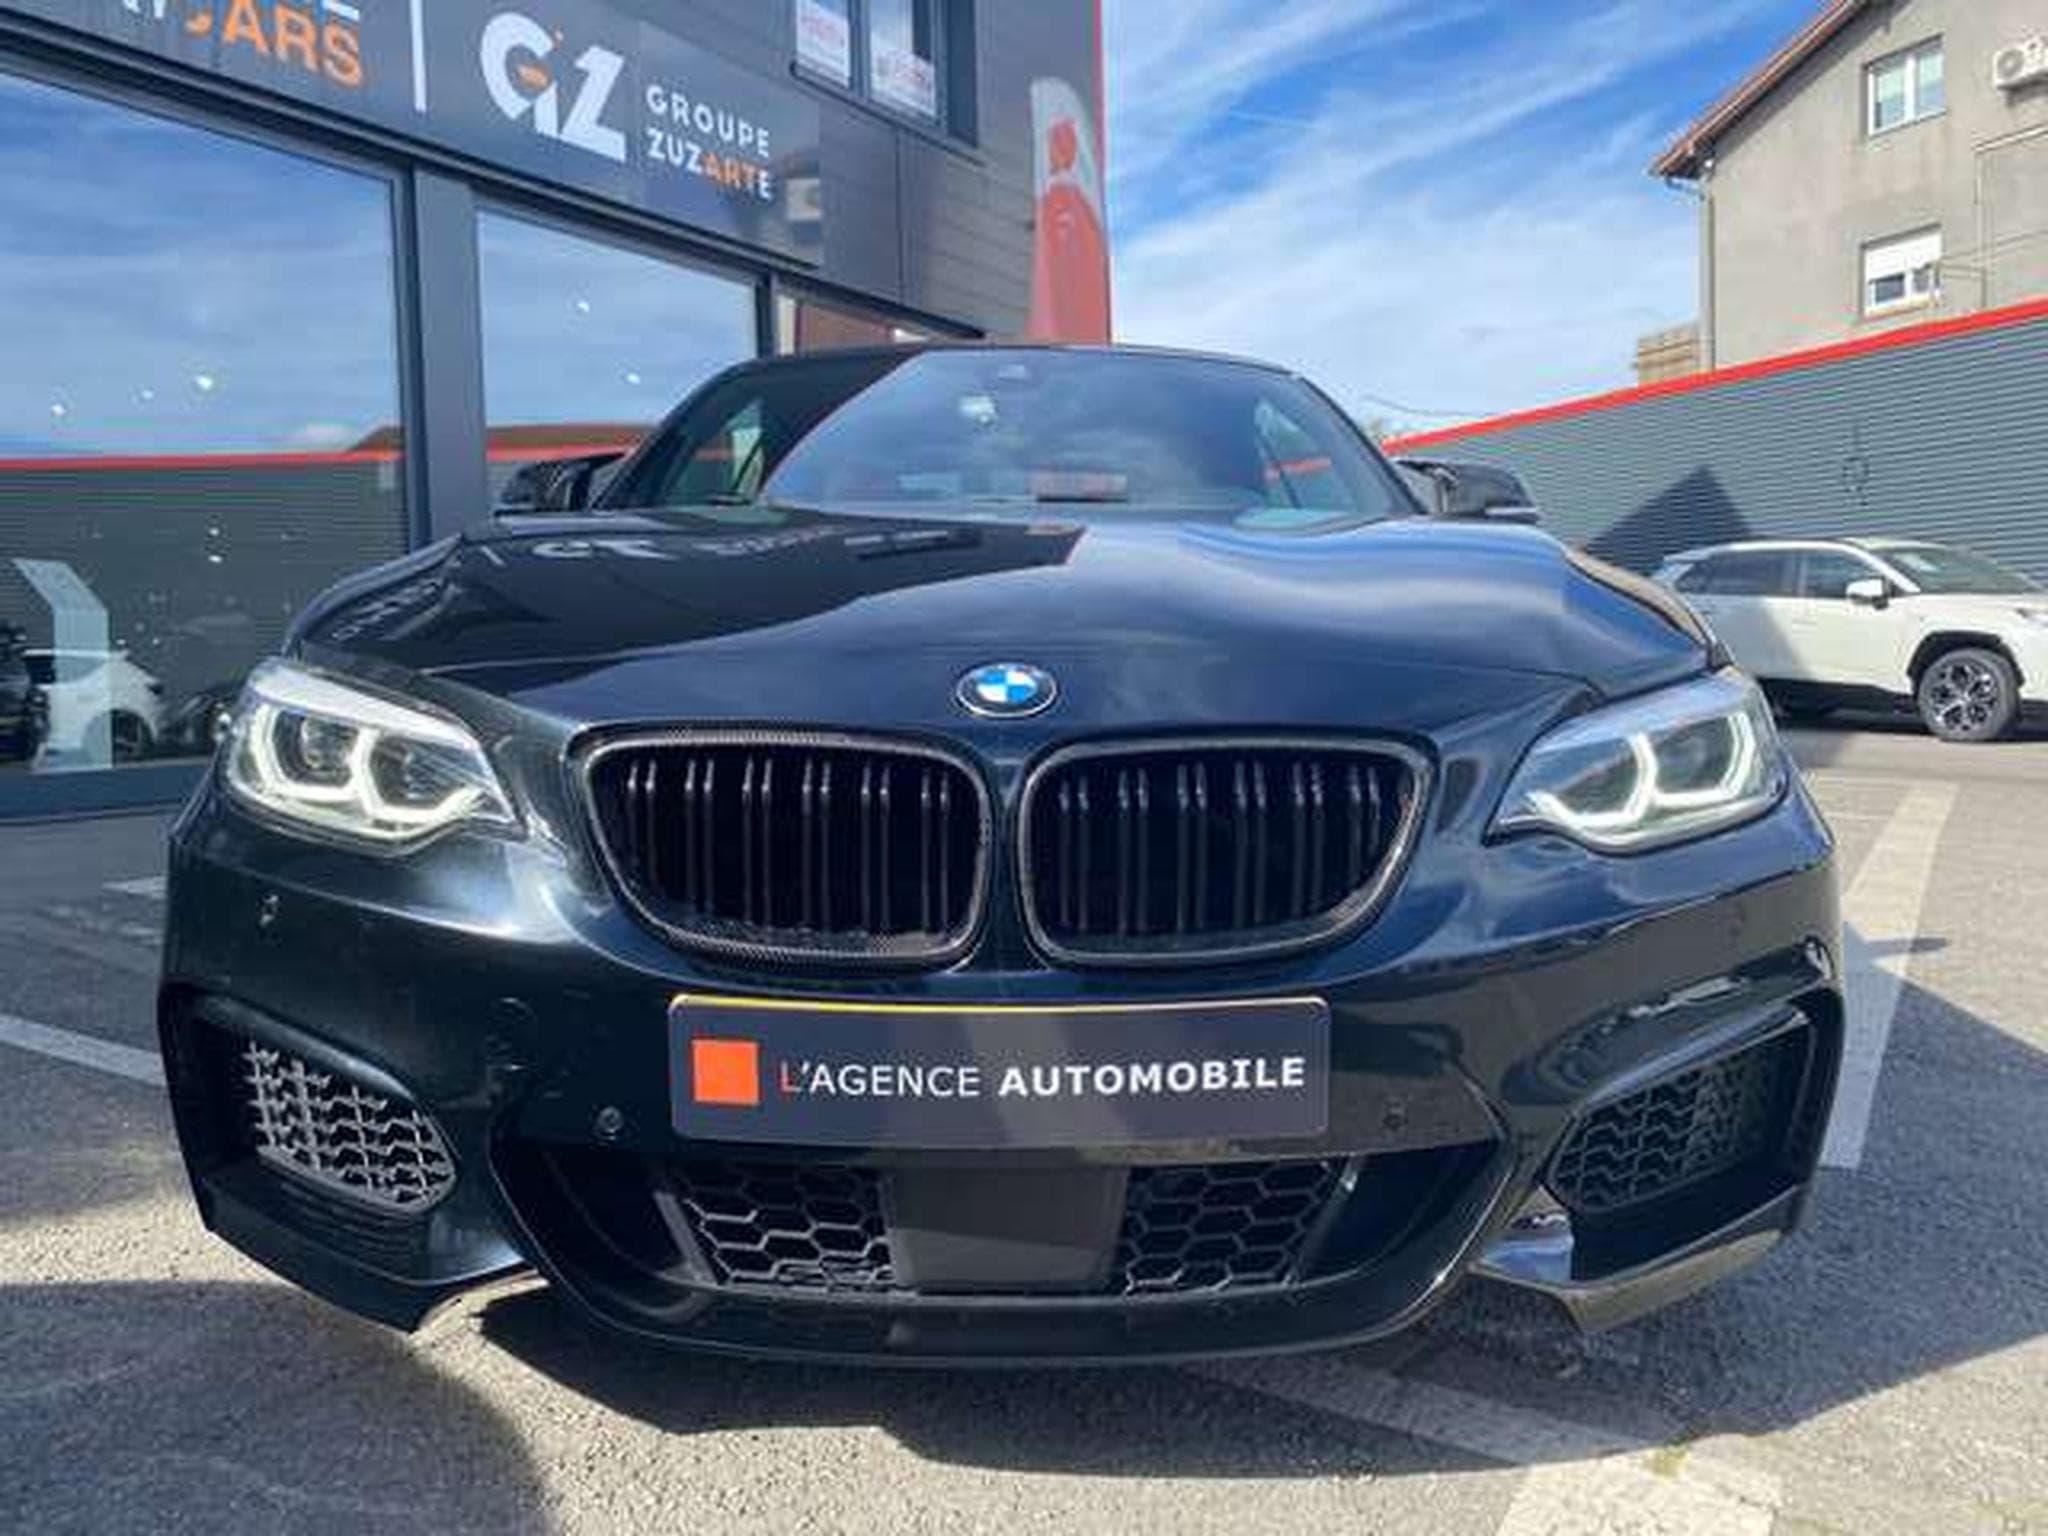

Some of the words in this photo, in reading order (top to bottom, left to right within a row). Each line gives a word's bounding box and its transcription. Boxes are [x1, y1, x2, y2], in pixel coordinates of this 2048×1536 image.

[646, 84, 769, 158] GROUPE
[646, 125, 771, 199] ZUZARTE
[777, 1060, 982, 1097] L'AGENCE
[998, 1057, 1306, 1096] AUTOMOBILE
